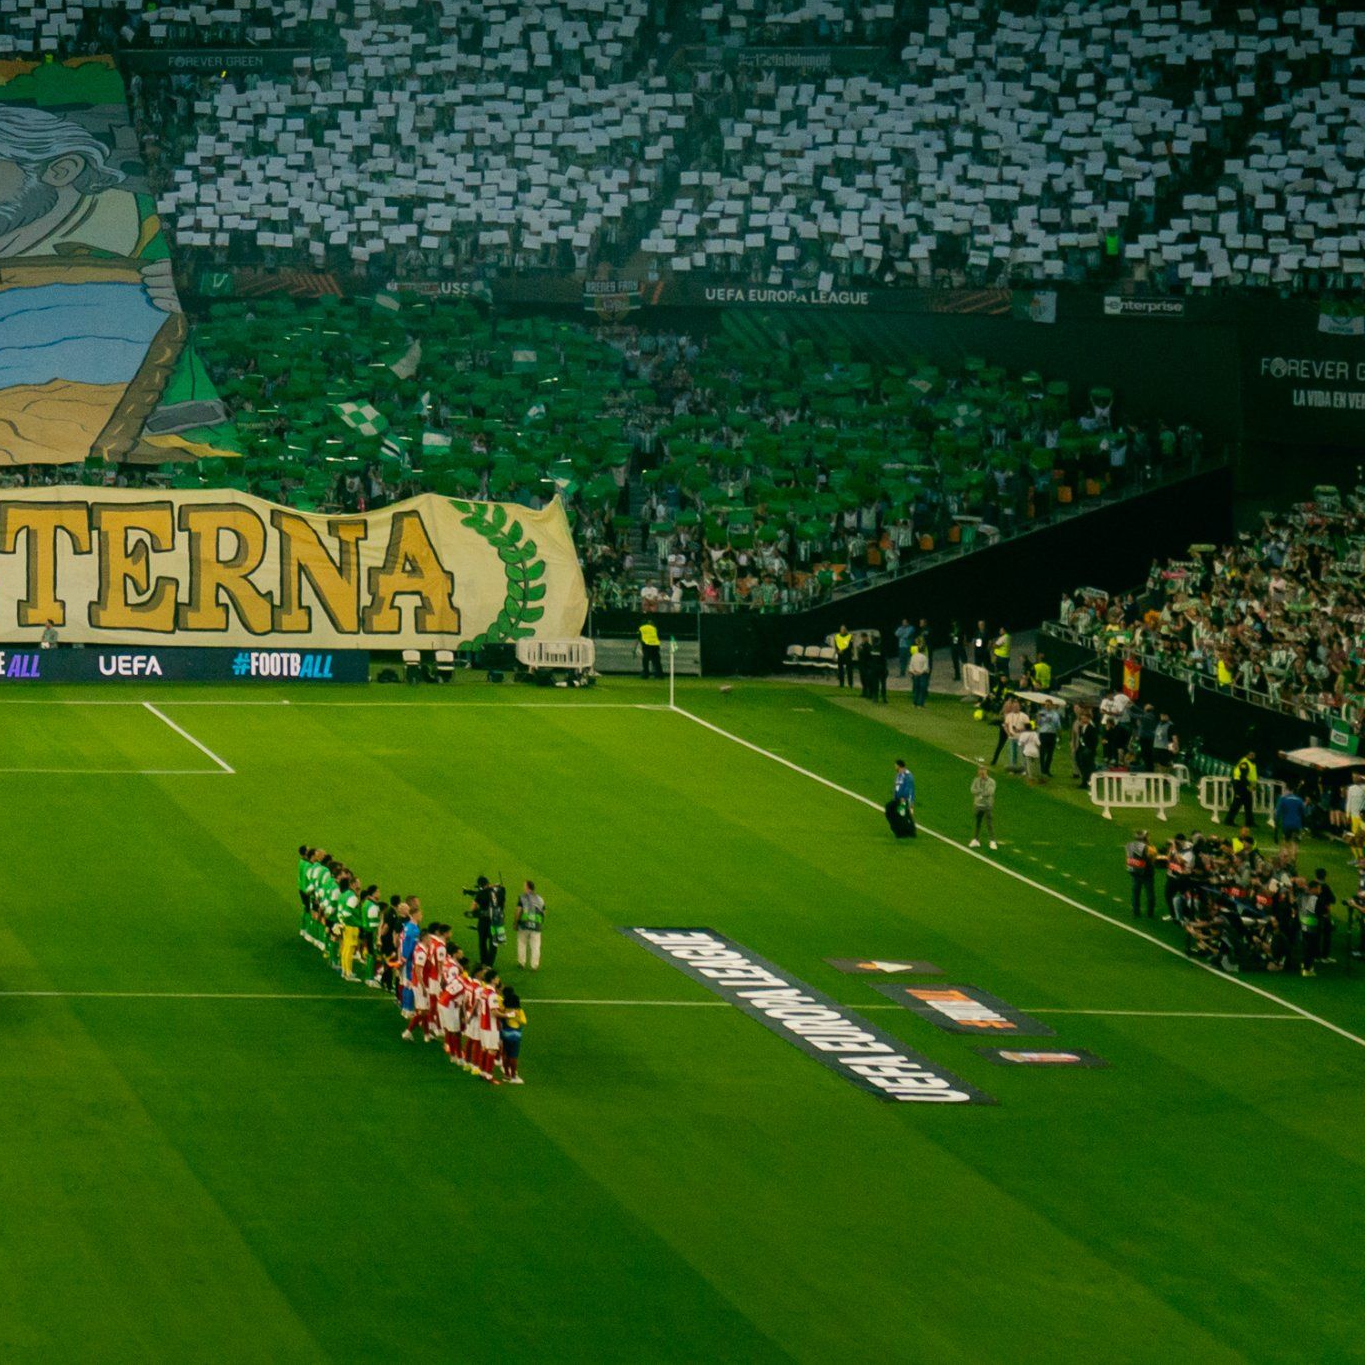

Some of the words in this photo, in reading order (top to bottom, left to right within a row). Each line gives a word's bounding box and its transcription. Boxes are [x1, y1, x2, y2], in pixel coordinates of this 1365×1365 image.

[169, 56, 222, 67] FOREVER
[225, 56, 263, 67] GREEN
[705, 287, 745, 302] UEFA
[748, 288, 808, 304] EUROPA
[810, 290, 869, 305] LEAGUE
[1109, 300, 1183, 313] enterprise
[1261, 357, 1349, 381] FOREVER
[1293, 389, 1305, 406] LA
[6, 654, 40, 678] ALL
[99, 655, 163, 676] UEFA
[232, 652, 333, 678] #FOOTBALL
[641, 930, 790, 987] LEAGUE
[736, 987, 896, 1053] EUROPA
[837, 1054, 971, 1103] UEFA
